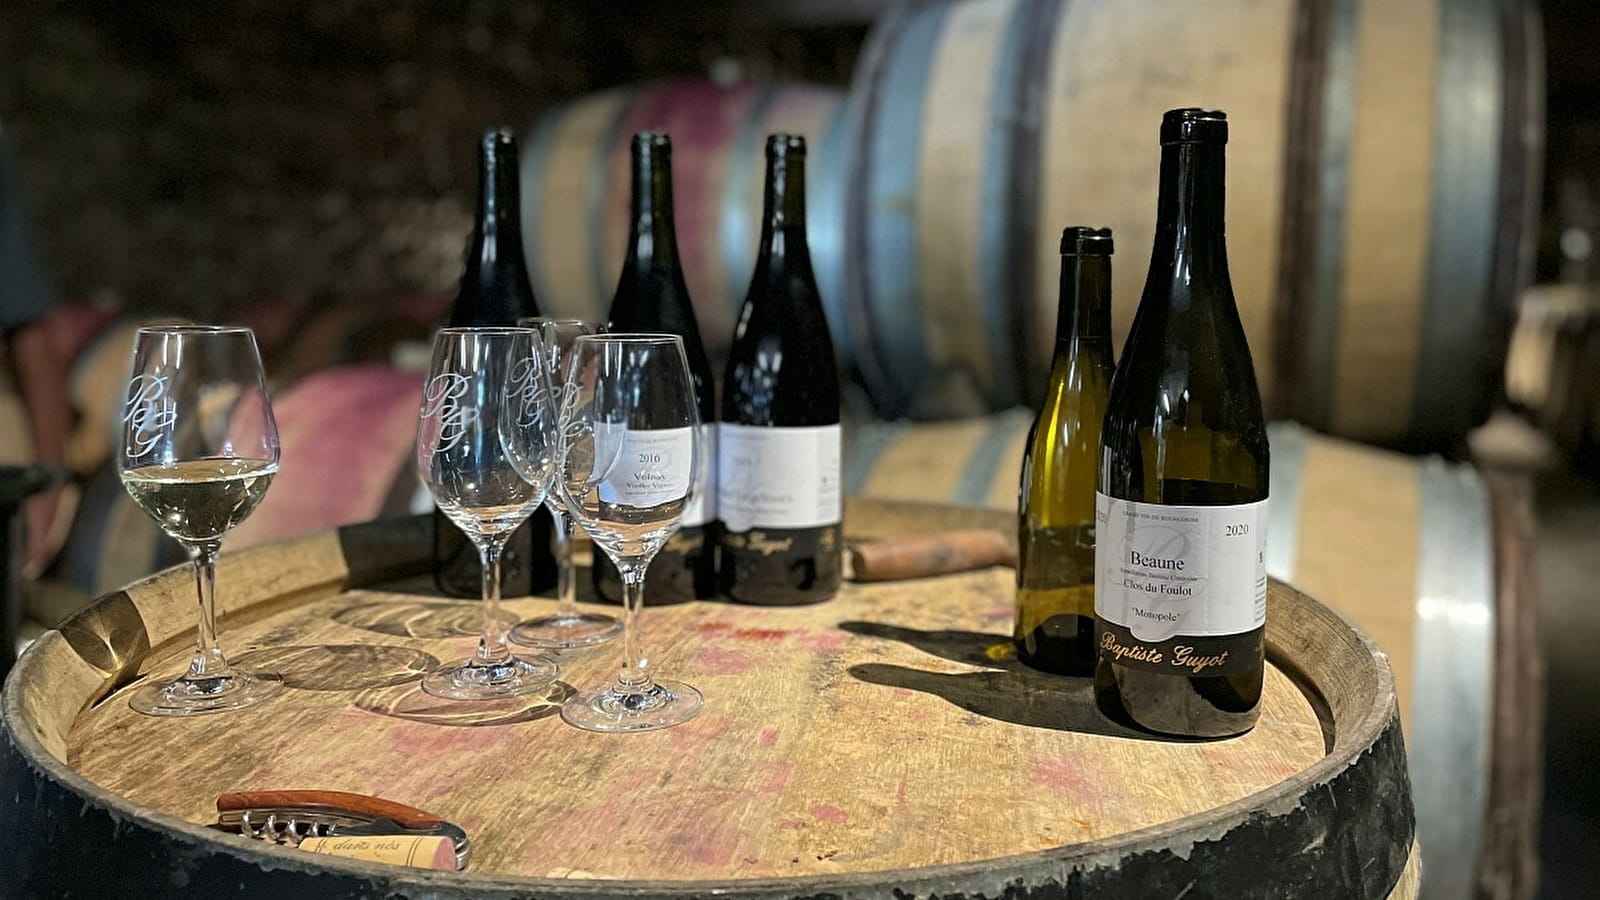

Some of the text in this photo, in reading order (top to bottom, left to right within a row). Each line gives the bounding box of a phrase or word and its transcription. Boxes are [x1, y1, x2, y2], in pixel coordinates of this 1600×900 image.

[639, 453, 661, 463] 2016
[633, 472, 667, 482] Volnay
[1225, 524, 1249, 537] 2020
[1131, 551, 1185, 571] Beaune
[1123, 579, 1192, 596] Clos du Foulot
[1132, 607, 1181, 622] "Monopole"
[1099, 631, 1229, 674] Baptiste Guyot
